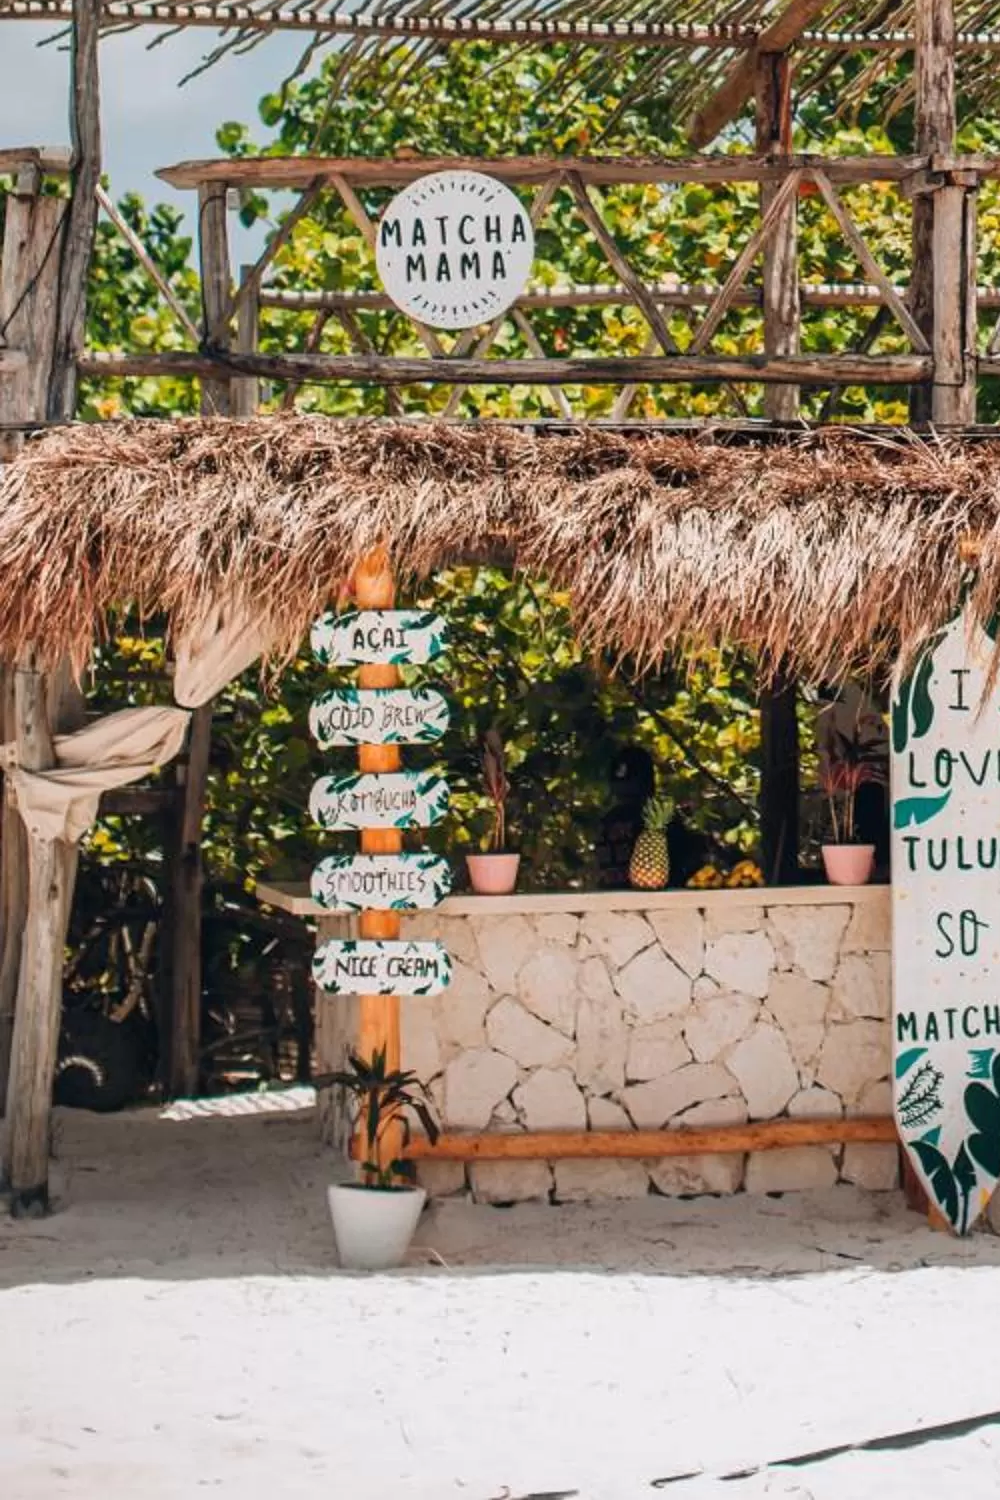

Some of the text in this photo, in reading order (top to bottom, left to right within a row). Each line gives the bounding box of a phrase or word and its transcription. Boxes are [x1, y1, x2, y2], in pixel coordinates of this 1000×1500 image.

[381, 213, 526, 247] MATCHA
[406, 250, 506, 282] MAMA
[949, 669, 970, 710] I
[383, 704, 426, 729] BREW
[326, 870, 426, 894] SMOOTHIES
[936, 909, 989, 958] SO
[335, 957, 439, 977] NICE CREAM
